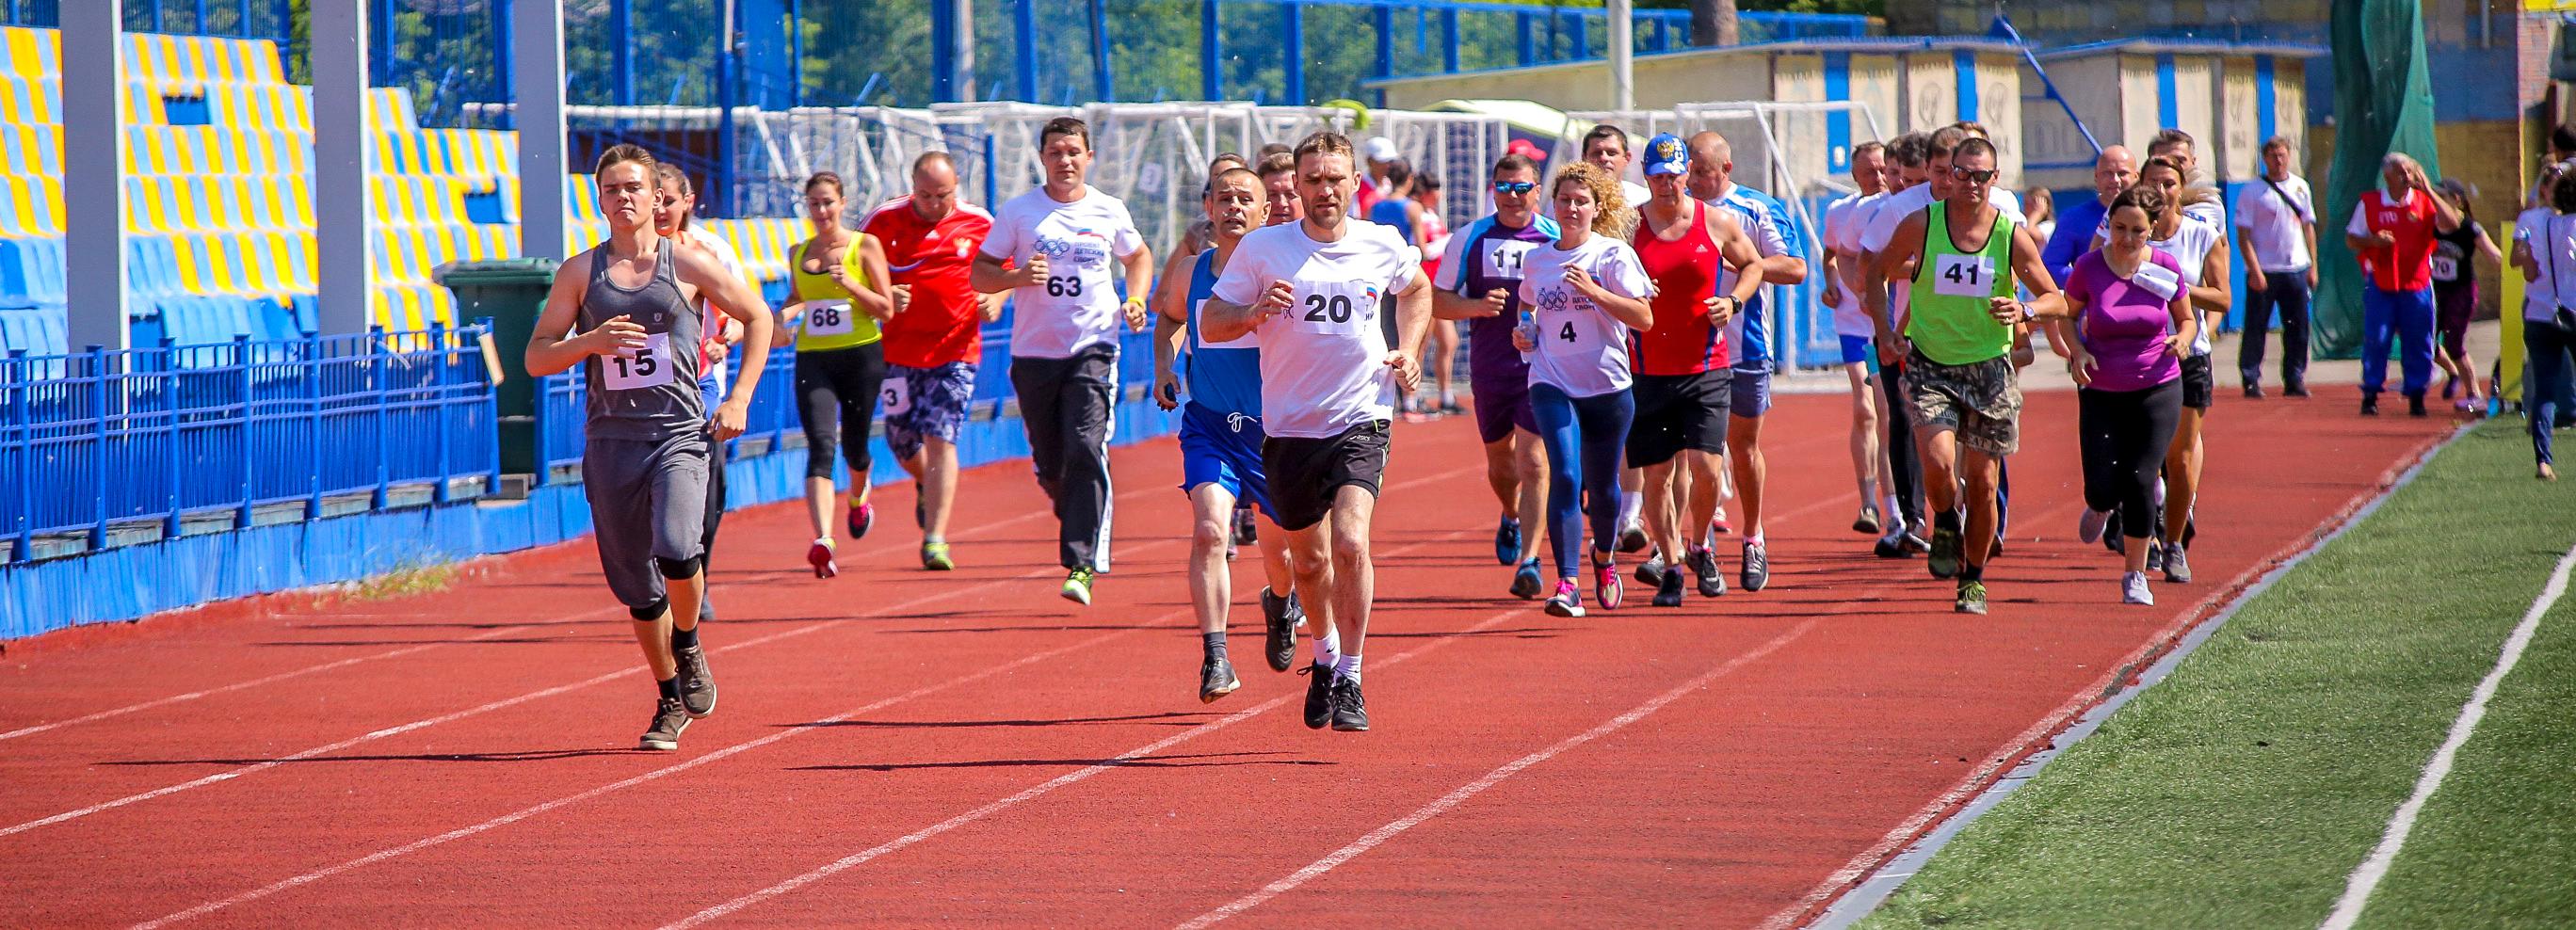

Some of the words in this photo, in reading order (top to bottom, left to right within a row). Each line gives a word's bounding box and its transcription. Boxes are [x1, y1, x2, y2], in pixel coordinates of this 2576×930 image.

[1492, 249, 1522, 269] 11
[1943, 263, 1978, 286] 41
[1046, 276, 1082, 297] 63
[812, 307, 840, 328] 68
[1304, 294, 1352, 324] 20
[1559, 320, 1577, 344] 4
[612, 347, 657, 378] 15
[885, 388, 898, 407] 3
